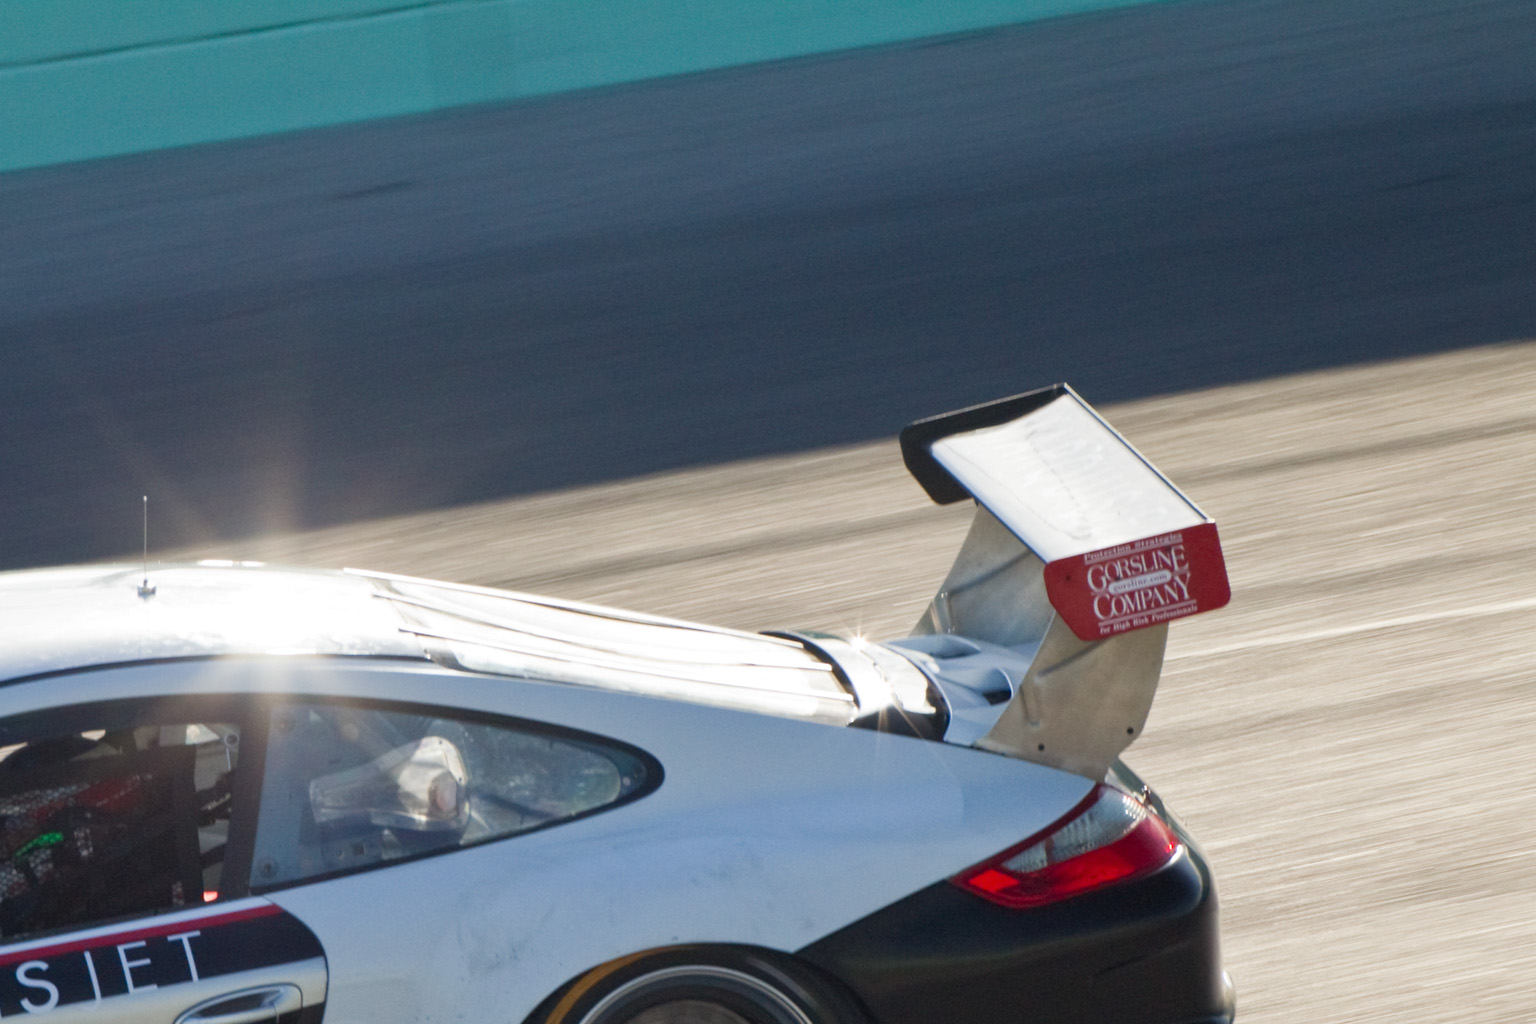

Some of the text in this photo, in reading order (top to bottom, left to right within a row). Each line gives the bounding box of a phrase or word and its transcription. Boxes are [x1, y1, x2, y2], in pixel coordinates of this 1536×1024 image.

[1084, 532, 1182, 562] Protection Strategies
[1087, 545, 1189, 593] GORSLINE
[1093, 573, 1191, 621] COMPANY
